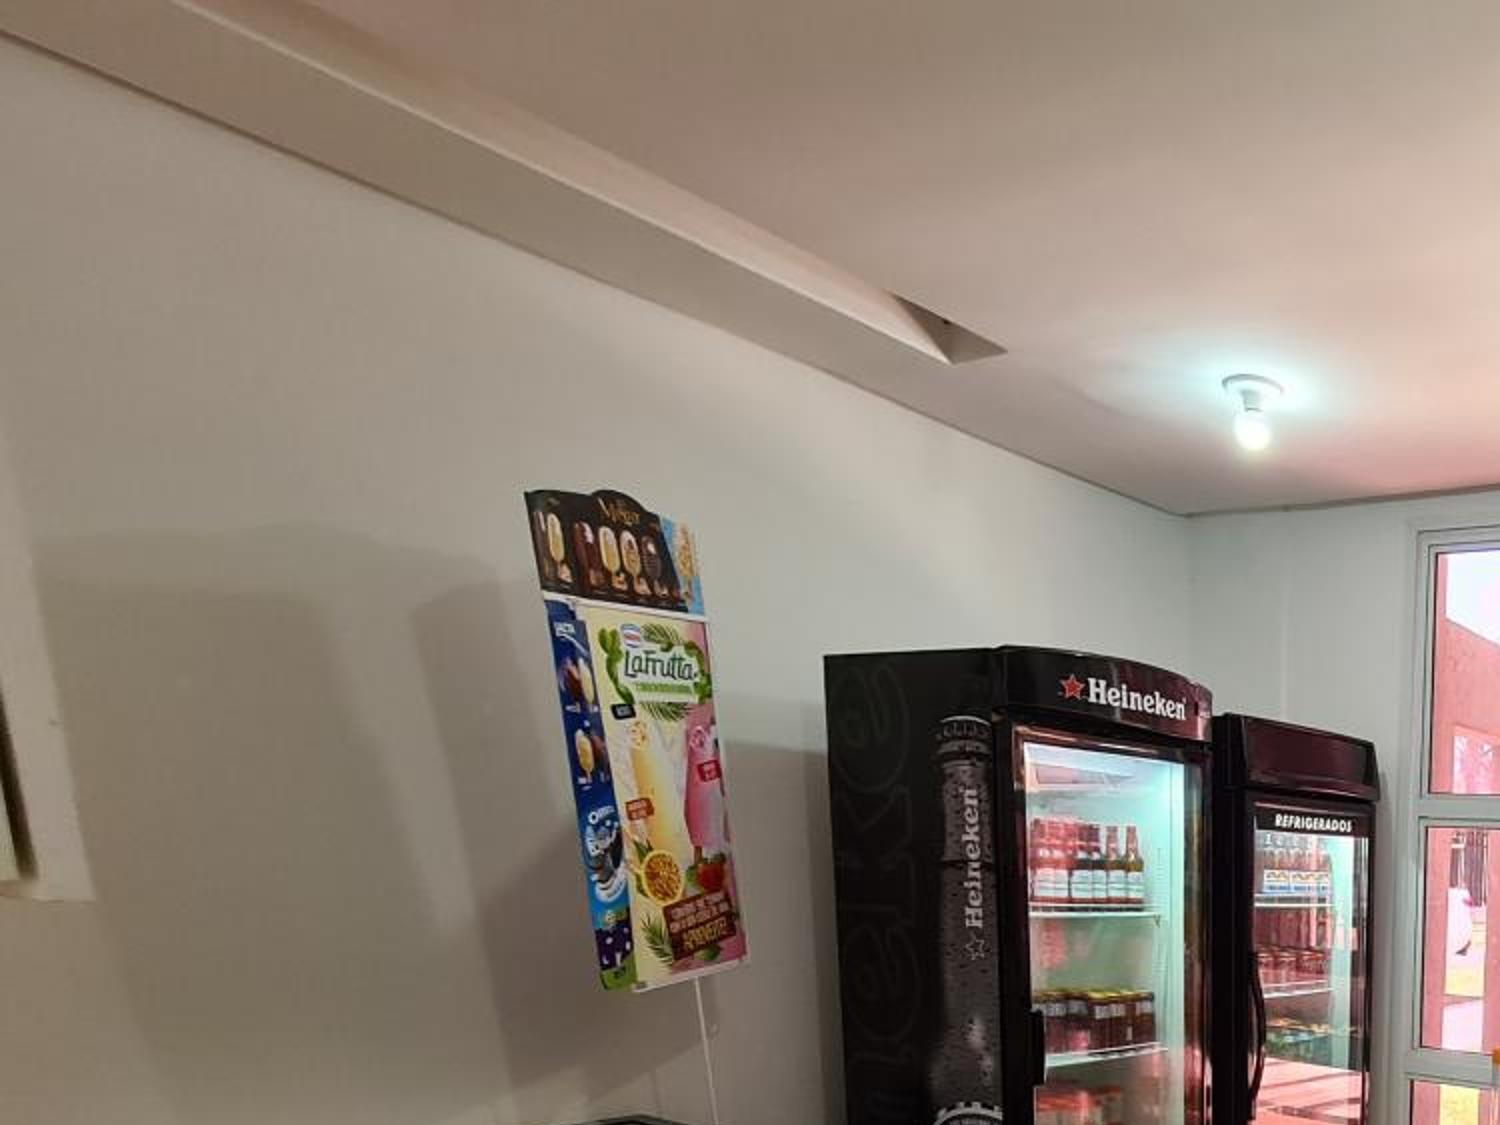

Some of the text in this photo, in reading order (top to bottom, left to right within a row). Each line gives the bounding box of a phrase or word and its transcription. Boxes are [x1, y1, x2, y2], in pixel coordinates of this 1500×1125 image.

[1087, 677, 1188, 721] Heineken
[1275, 813, 1353, 833] REFRIGERADOS
[961, 787, 985, 930] Heineken
